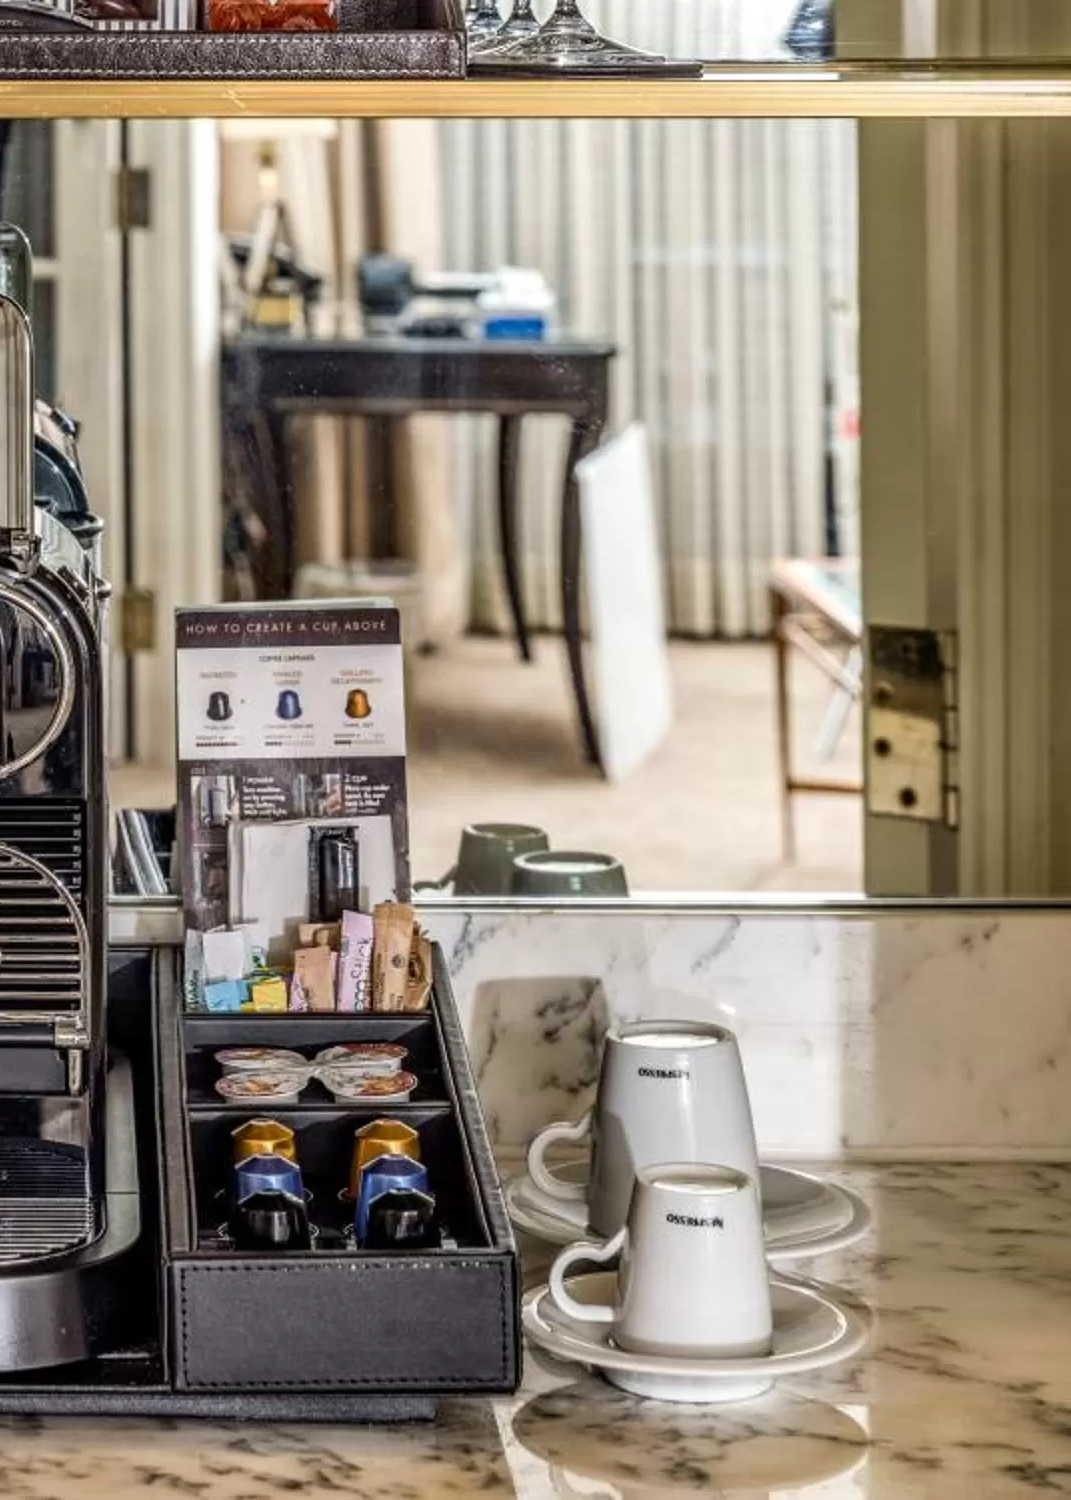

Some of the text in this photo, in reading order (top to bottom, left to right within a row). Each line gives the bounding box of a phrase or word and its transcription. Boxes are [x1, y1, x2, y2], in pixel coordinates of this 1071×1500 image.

[186, 620, 386, 635] HOW TO CREATE A CUP ABOVE
